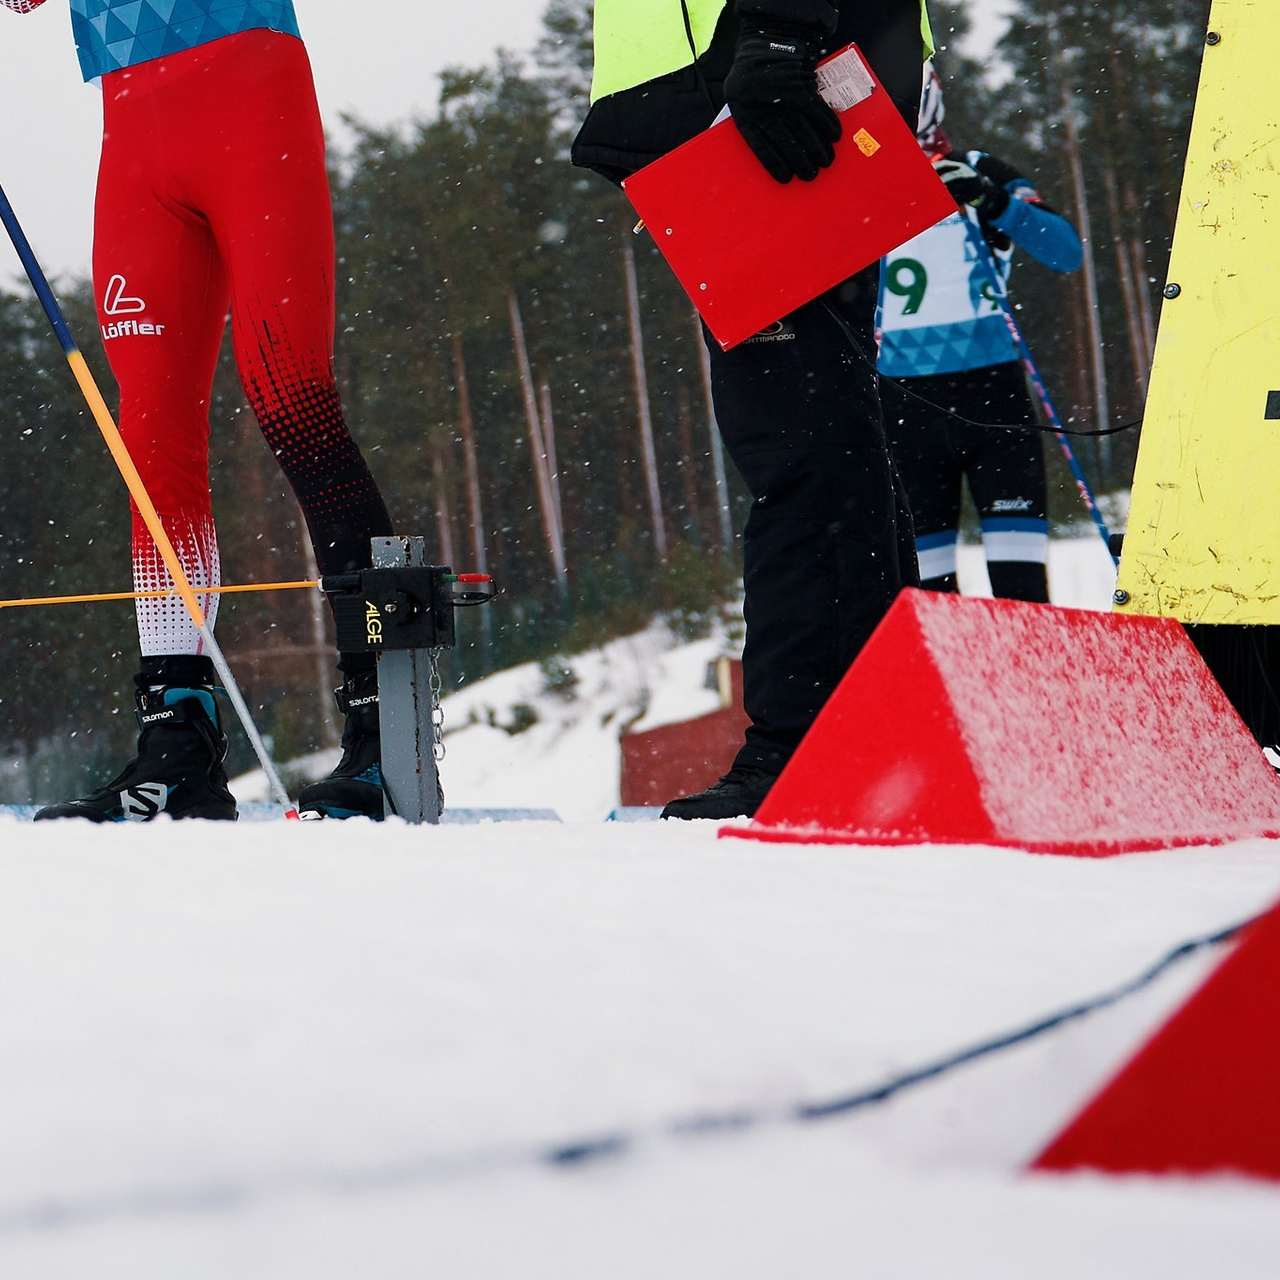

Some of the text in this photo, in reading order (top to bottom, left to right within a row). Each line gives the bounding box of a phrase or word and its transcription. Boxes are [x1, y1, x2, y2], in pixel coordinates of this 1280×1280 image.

[886, 258, 927, 315] 9
[102, 320, 165, 340] Löffler
[365, 600, 383, 644] ALGE
